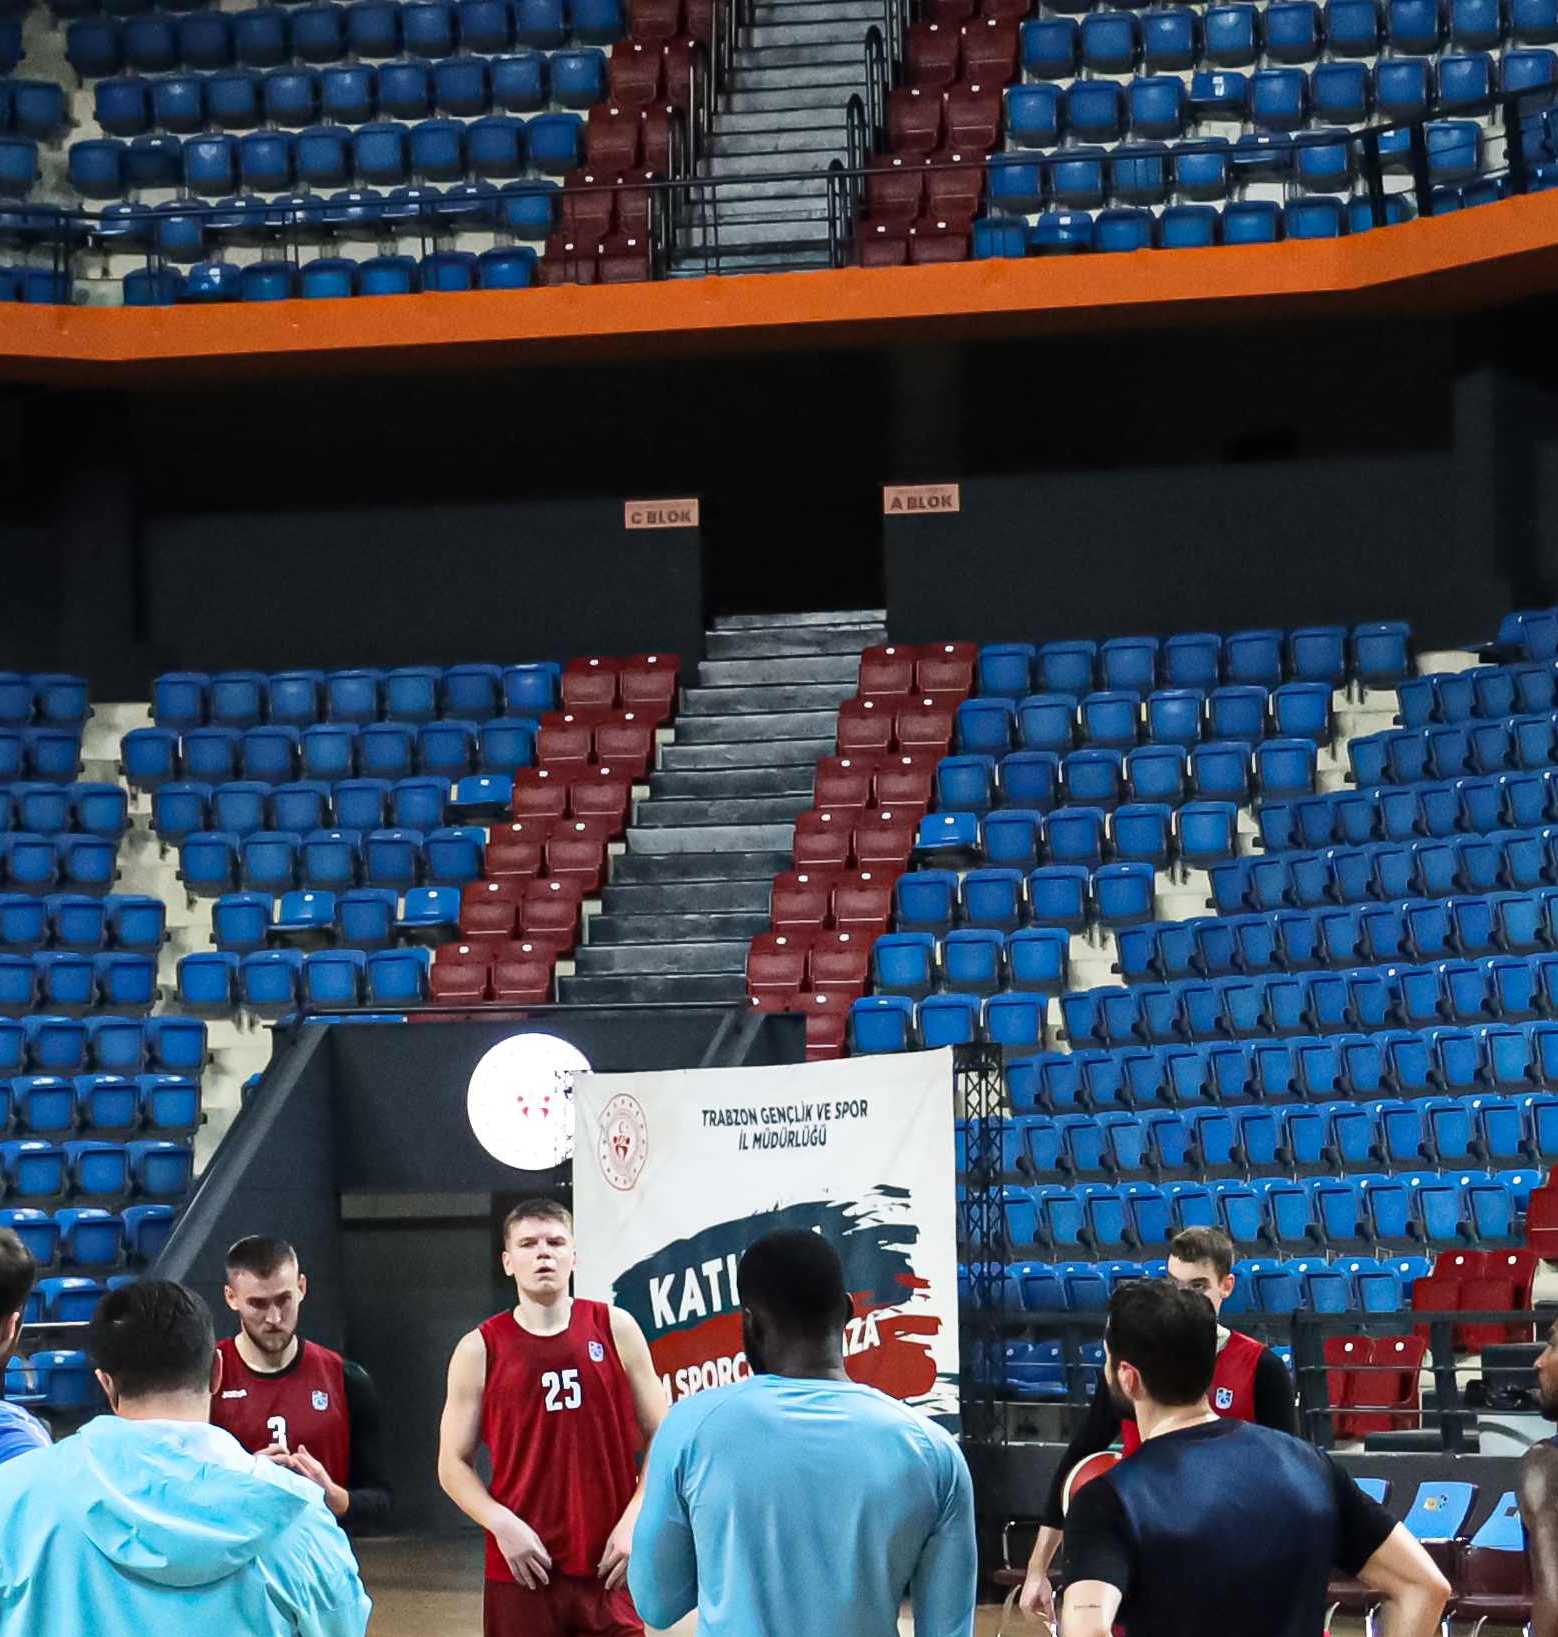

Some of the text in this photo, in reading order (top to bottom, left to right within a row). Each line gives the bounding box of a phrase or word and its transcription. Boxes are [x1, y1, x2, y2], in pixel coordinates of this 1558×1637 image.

[890, 495, 952, 510] A BLOK
[631, 510, 691, 525] C BLOK
[702, 1099, 868, 1127] TRABZON GENÇLİK VE SPOR
[739, 1124, 827, 1151] İL MÜDÜRLÜĞÜ
[542, 1369, 581, 1411] 25
[267, 1416, 288, 1452] 3
